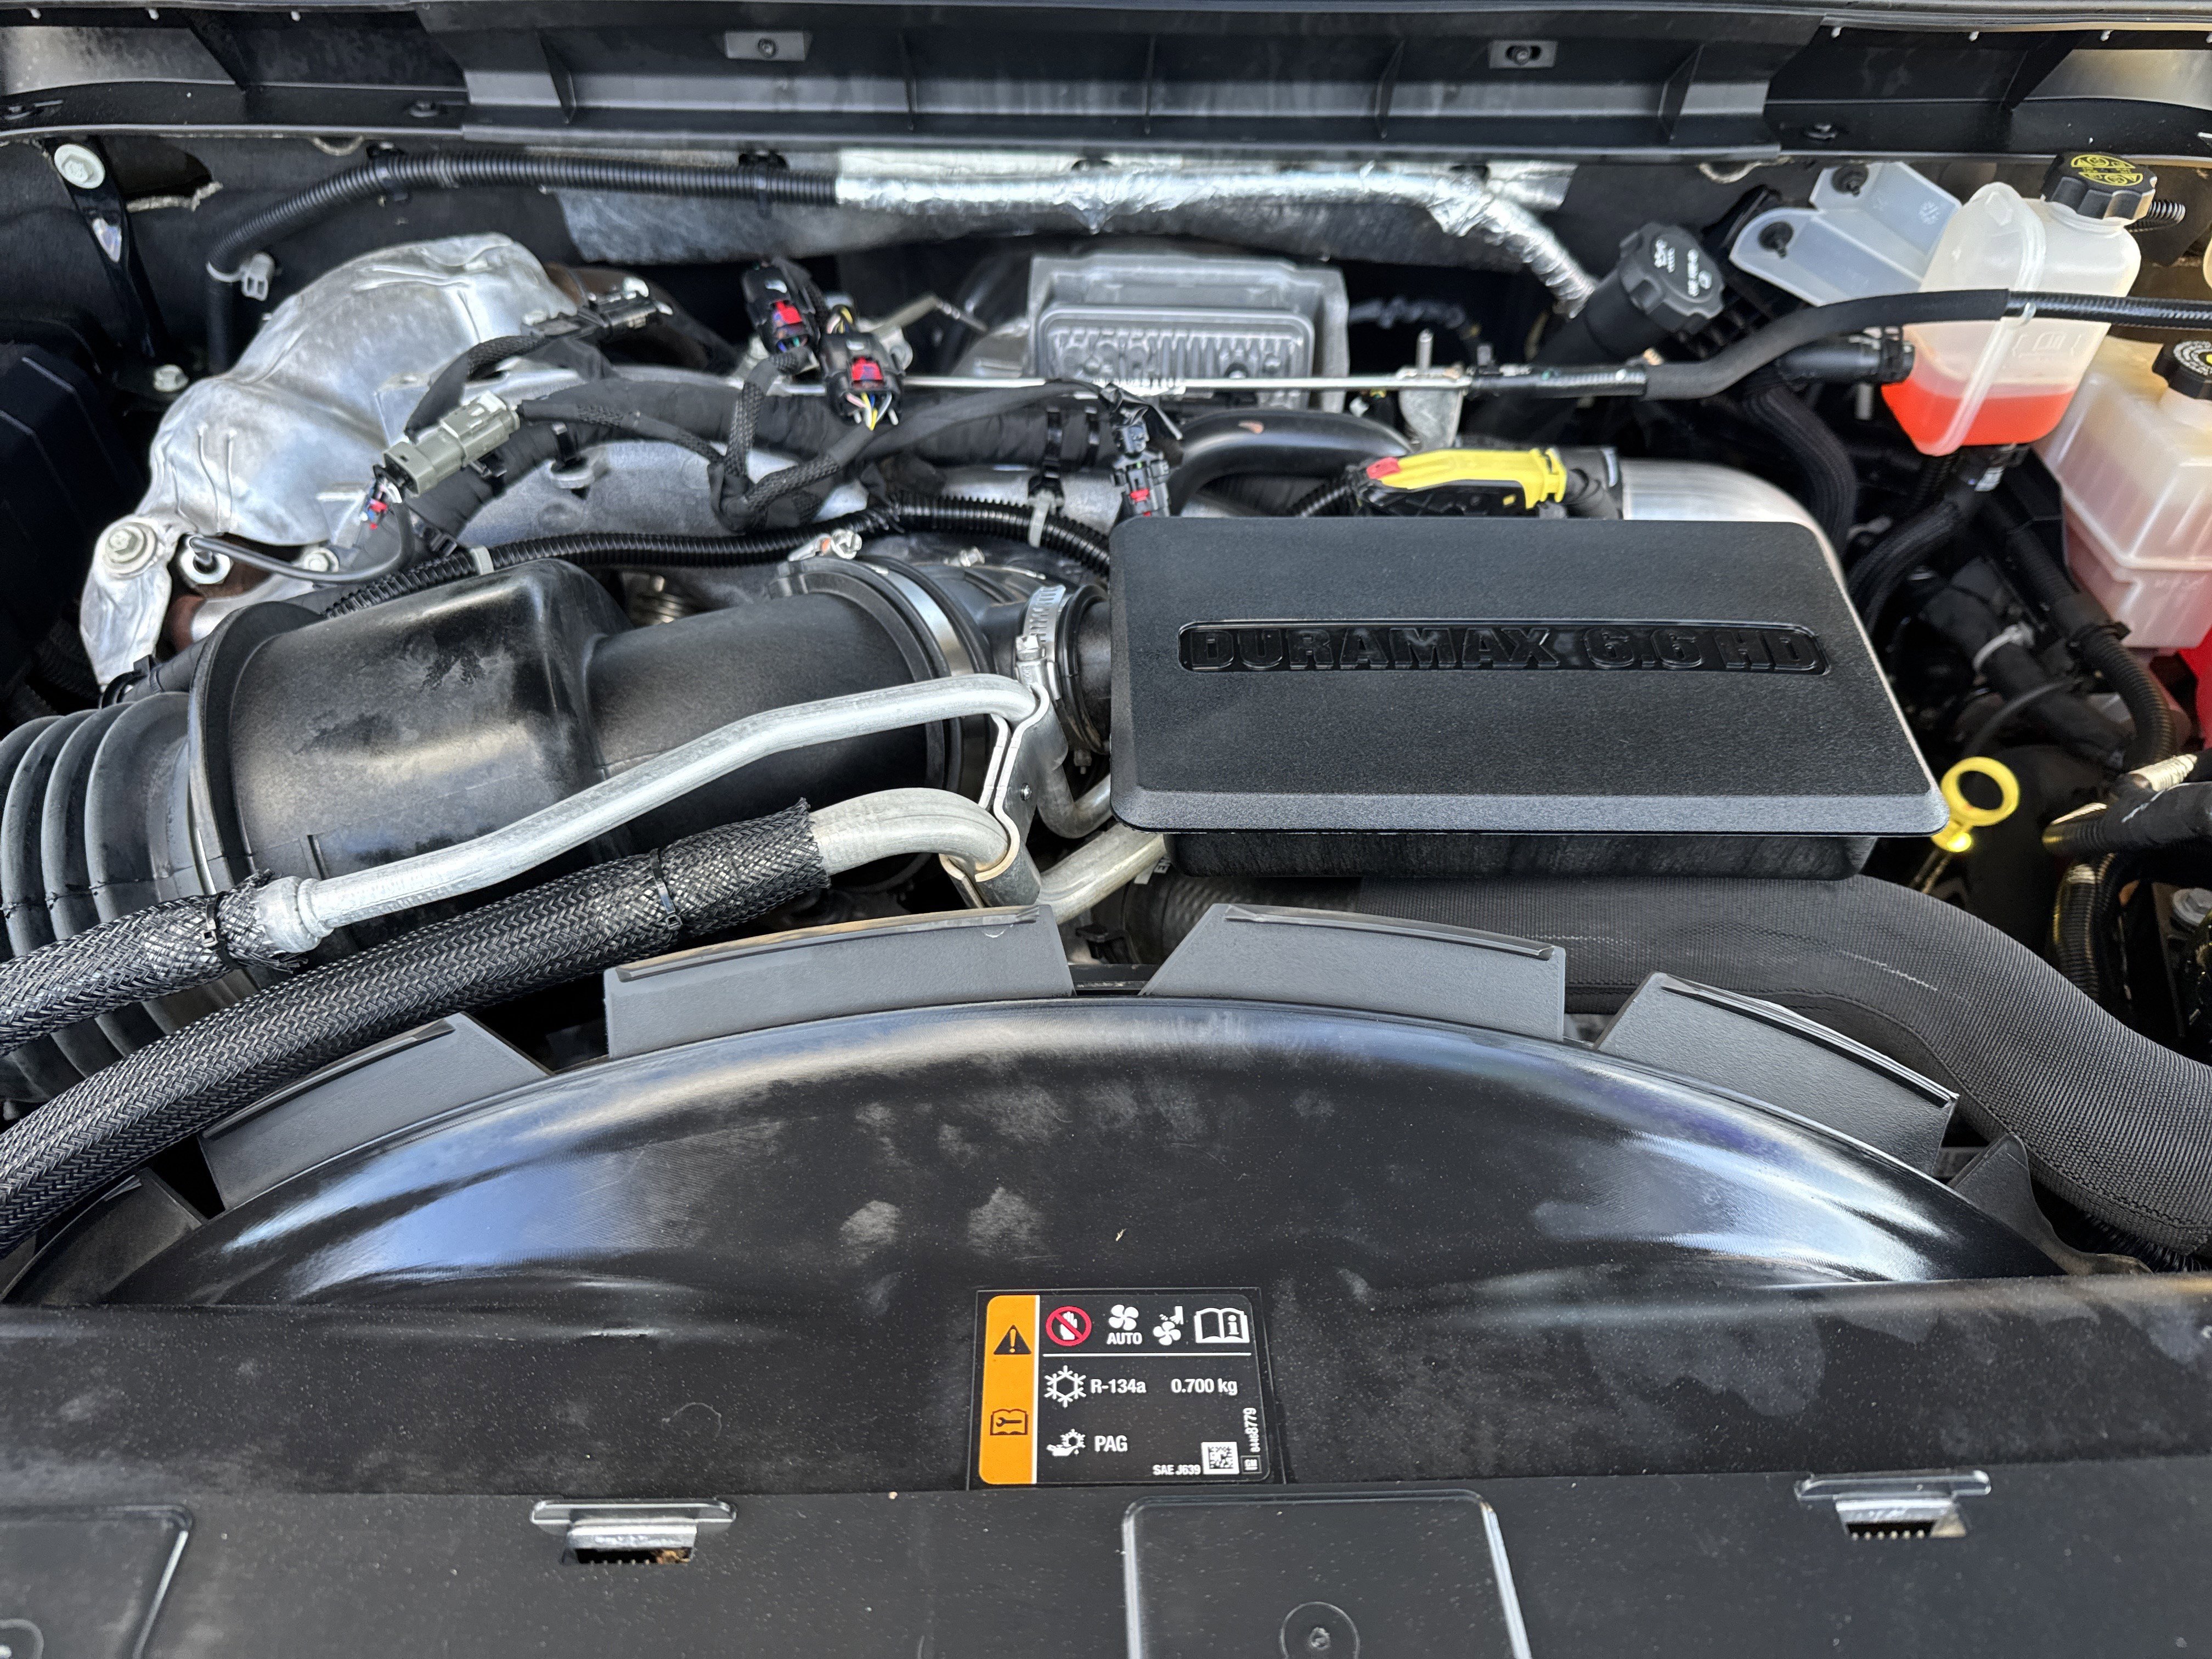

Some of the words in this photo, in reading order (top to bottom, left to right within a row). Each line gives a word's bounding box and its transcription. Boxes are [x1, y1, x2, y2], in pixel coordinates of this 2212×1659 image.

[1190, 628, 1559, 670] DURAMAX
[1584, 628, 1703, 669] 6.6
[1714, 629, 1816, 671] HD
[1107, 1332, 1142, 1345] AUTO
[1090, 1379, 1147, 1393] R-134a
[1171, 1378, 1215, 1393] 0.700
[1217, 1378, 1238, 1396] kg
[1094, 1435, 1128, 1452] PAG
[1153, 1464, 1175, 1475] SAE
[1175, 1464, 1201, 1475] J639
